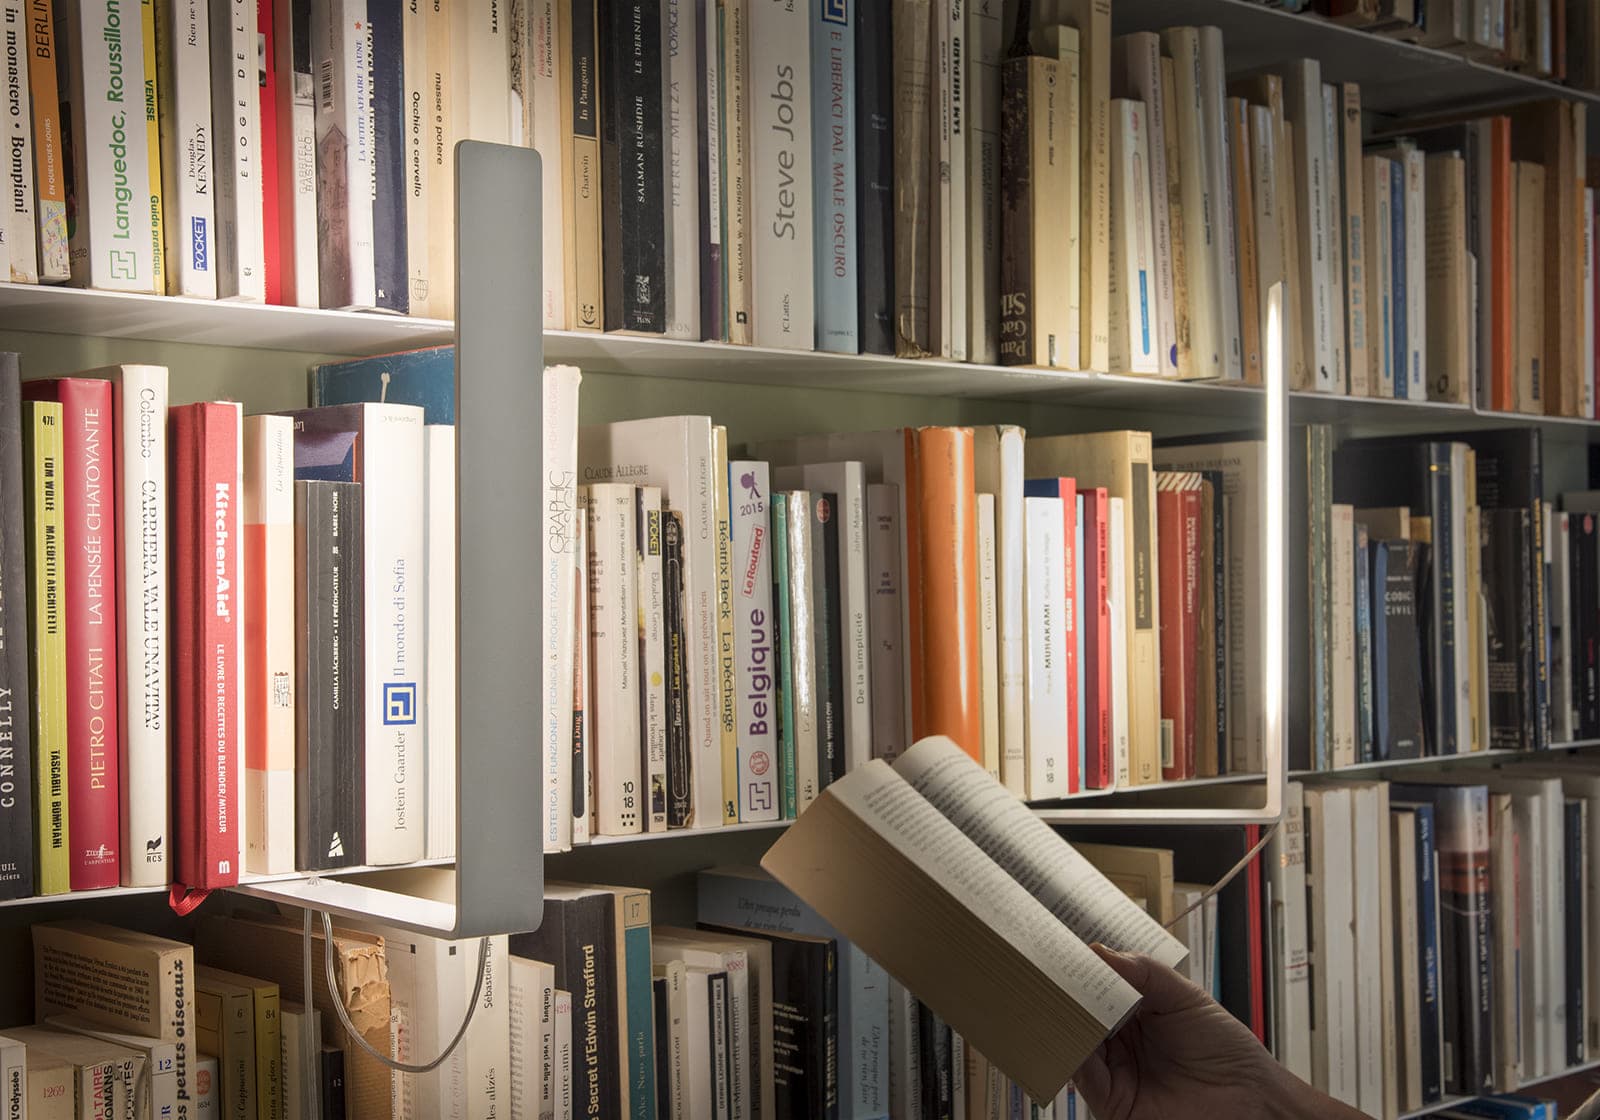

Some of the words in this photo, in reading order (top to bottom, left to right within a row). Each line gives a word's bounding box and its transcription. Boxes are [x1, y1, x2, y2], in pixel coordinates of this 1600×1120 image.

[5, 7, 17, 22] in
[190, 8, 197, 21] ne
[632, 5, 642, 56] DERNIER
[188, 24, 198, 47] Rien
[354, 39, 363, 70] JAUNE
[831, 31, 843, 41] E
[6, 31, 20, 117] monastero
[236, 54, 246, 80] DE
[578, 55, 590, 105] Patagonia
[634, 60, 643, 74] LE
[830, 47, 844, 118] LIBERACI
[953, 37, 961, 102] SHEPARD
[145, 80, 156, 121] VENISE
[356, 72, 364, 112] AFFAIRE
[412, 91, 421, 133] Occhio
[435, 73, 444, 111] masse
[669, 81, 680, 141] MILZA
[770, 64, 795, 142] Jobs
[45, 116, 53, 143] JOURS
[356, 115, 365, 146] PETITE
[435, 115, 443, 123] e
[580, 110, 589, 120] In
[635, 95, 644, 148] RUSHDIE
[195, 124, 208, 195] KENNEDY
[357, 149, 365, 161] LA
[434, 126, 444, 165] potere
[831, 124, 845, 156] DAL
[11, 136, 27, 213] Bompiani
[46, 143, 55, 183] QUELQUES
[109, 108, 133, 240] Languedoc,
[413, 150, 422, 196] cervello
[581, 155, 591, 199] Chatwin
[636, 153, 645, 203] SALMAN
[48, 183, 56, 197] EN
[772, 150, 796, 241] Steve
[832, 162, 846, 206] MALE
[151, 195, 160, 222] Guide
[150, 229, 160, 276] pratique
[193, 216, 207, 271] POCKET
[833, 212, 847, 278] OSCURO
[139, 388, 156, 459] Colombo
[44, 457, 54, 477] TOM
[84, 408, 101, 531] CHATOYANTE
[45, 480, 55, 511] WOLFE
[549, 470, 564, 555] GRAPHIC
[740, 503, 763, 517] 2015
[618, 512, 627, 531] sud
[648, 511, 660, 556] POCKET
[700, 500, 708, 540] CLAUDE
[45, 525, 56, 576] MALEDETTI
[84, 536, 103, 598] PENSÉE
[215, 482, 231, 617] KitchenAid
[619, 541, 627, 561] mers
[718, 520, 728, 574] Béatrix
[331, 566, 340, 618] PRÉDICATEUR
[393, 558, 406, 594] Sofia
[651, 571, 660, 609] Elizabeth
[46, 580, 57, 635] ARCHITETTI
[90, 602, 103, 625] LA
[143, 586, 160, 632] VALE
[393, 596, 406, 611] di
[719, 578, 730, 620] Beck
[332, 618, 339, 628] LE
[393, 613, 406, 663] mondo
[650, 611, 660, 642] George
[853, 612, 866, 671] simplicité
[1043, 603, 1052, 669] MURAKAMI
[144, 637, 160, 681] UNA
[217, 644, 224, 656] LE
[331, 635, 340, 675] LÄCKBERG
[722, 632, 731, 656] La
[88, 647, 104, 711] CITATI
[217, 656, 225, 681] LIVRE
[217, 682, 225, 693] DE
[393, 667, 405, 676] Il
[620, 661, 629, 690] Manuel
[746, 608, 772, 736] Belgique
[854, 676, 865, 686] la
[144, 678, 161, 731] VITA?
[650, 693, 658, 712] dans
[722, 657, 735, 733] Décharge
[855, 690, 866, 705] De
[217, 696, 226, 739] RECETTES
[574, 714, 583, 738] Ding
[702, 717, 712, 748] Quand
[825, 701, 834, 740] WINSLOW
[0, 686, 14, 808] CONNELLY
[89, 716, 105, 790] PIETRO
[218, 740, 226, 753] DU
[394, 730, 407, 785] Gaarder
[574, 742, 582, 755] Ya
[650, 723, 659, 763] brouillard
[826, 741, 836, 760] DON
[50, 749, 61, 797] TASCABILI
[623, 781, 635, 794] 10
[217, 755, 227, 833] BLENDER/MIXEUR
[394, 786, 408, 831] Jostein
[623, 796, 635, 809] 18
[51, 801, 62, 849] BOMPIANI
[549, 788, 558, 842] ESTETICA
[146, 855, 162, 863] RCS
[581, 943, 596, 1009] Strafford
[171, 959, 185, 1038] oiseaux
[541, 987, 552, 1024] Ginzburg
[559, 1042, 568, 1072] amis
[583, 1010, 598, 1066] d'Edwin
[175, 1042, 190, 1100] petits
[485, 1067, 496, 1101] alizés
[542, 1062, 551, 1082] della
[543, 1082, 551, 1100] sera
[559, 1074, 568, 1107] entre
[585, 1067, 600, 1114] Secret
